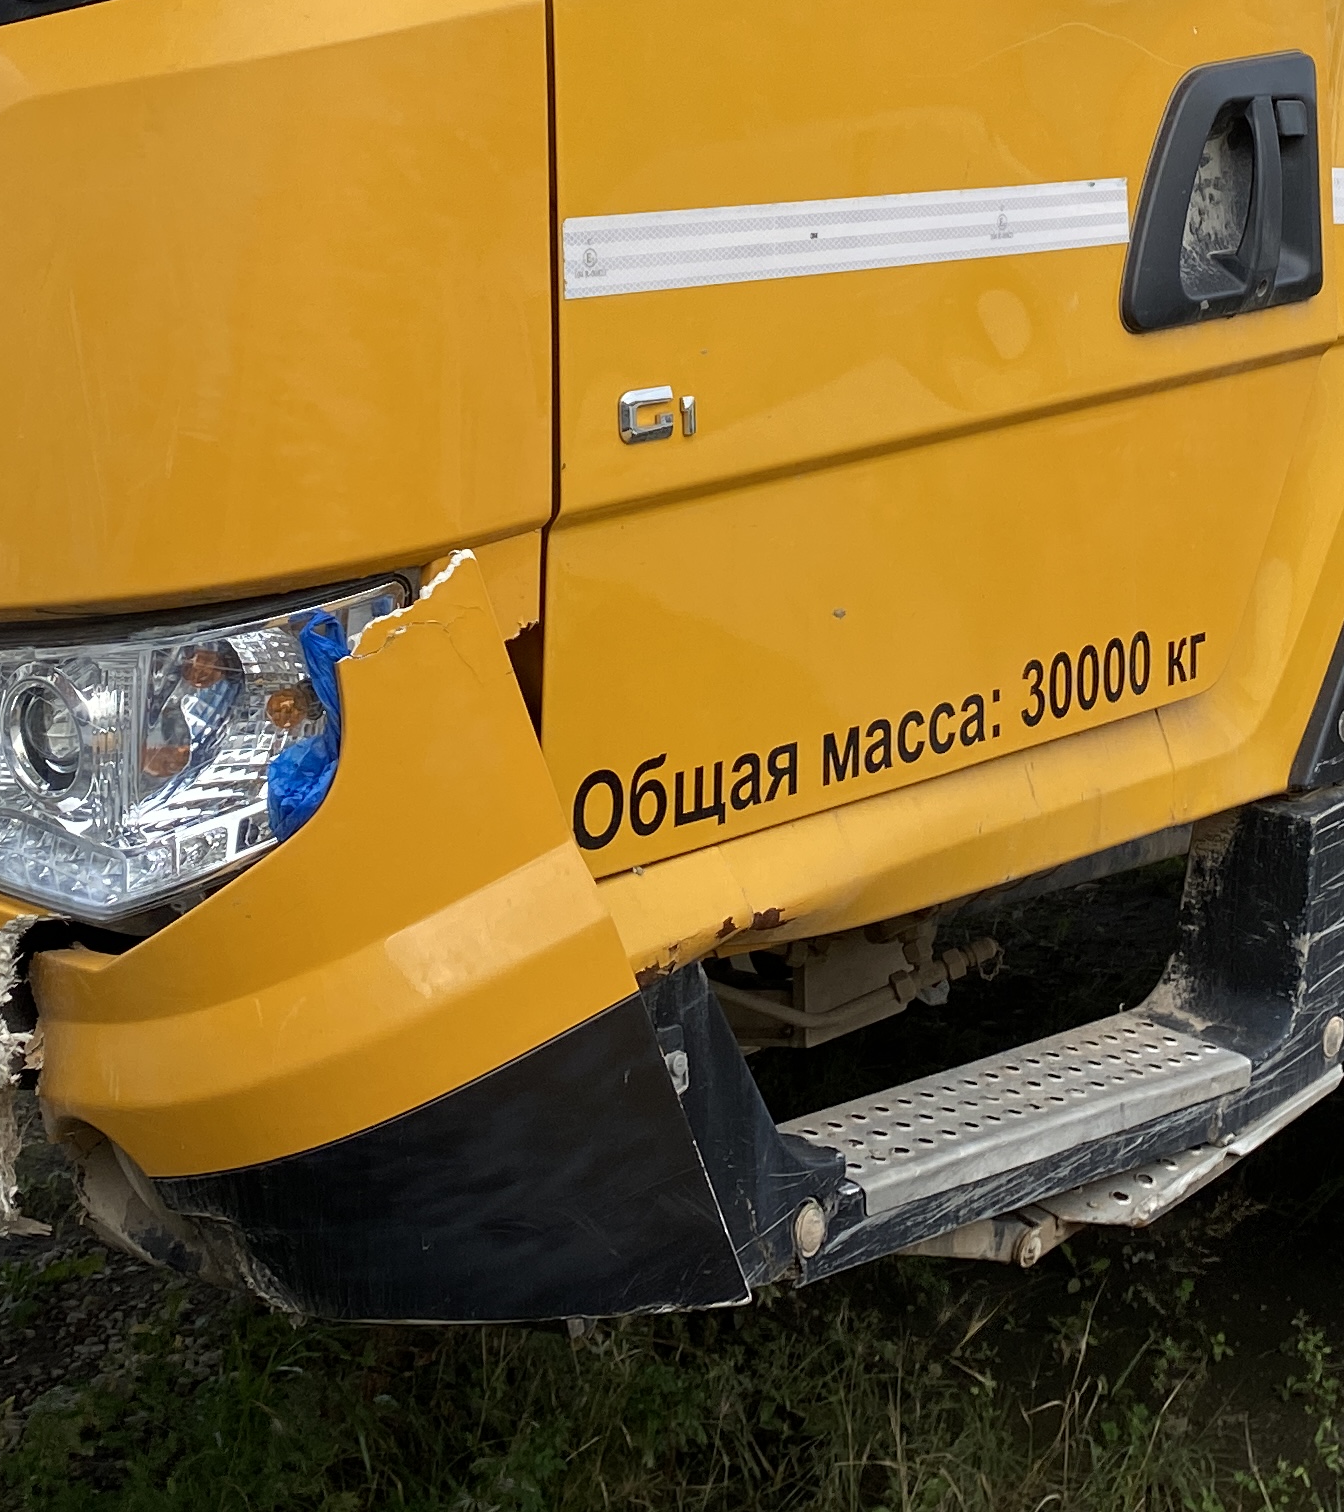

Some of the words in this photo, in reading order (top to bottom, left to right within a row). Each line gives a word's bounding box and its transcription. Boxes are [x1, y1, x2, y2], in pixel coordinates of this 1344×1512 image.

[572, 742, 799, 851] Общая
[822, 689, 1002, 786] масса:
[1020, 630, 1151, 728] 30000
[1167, 631, 1206, 687] кг
